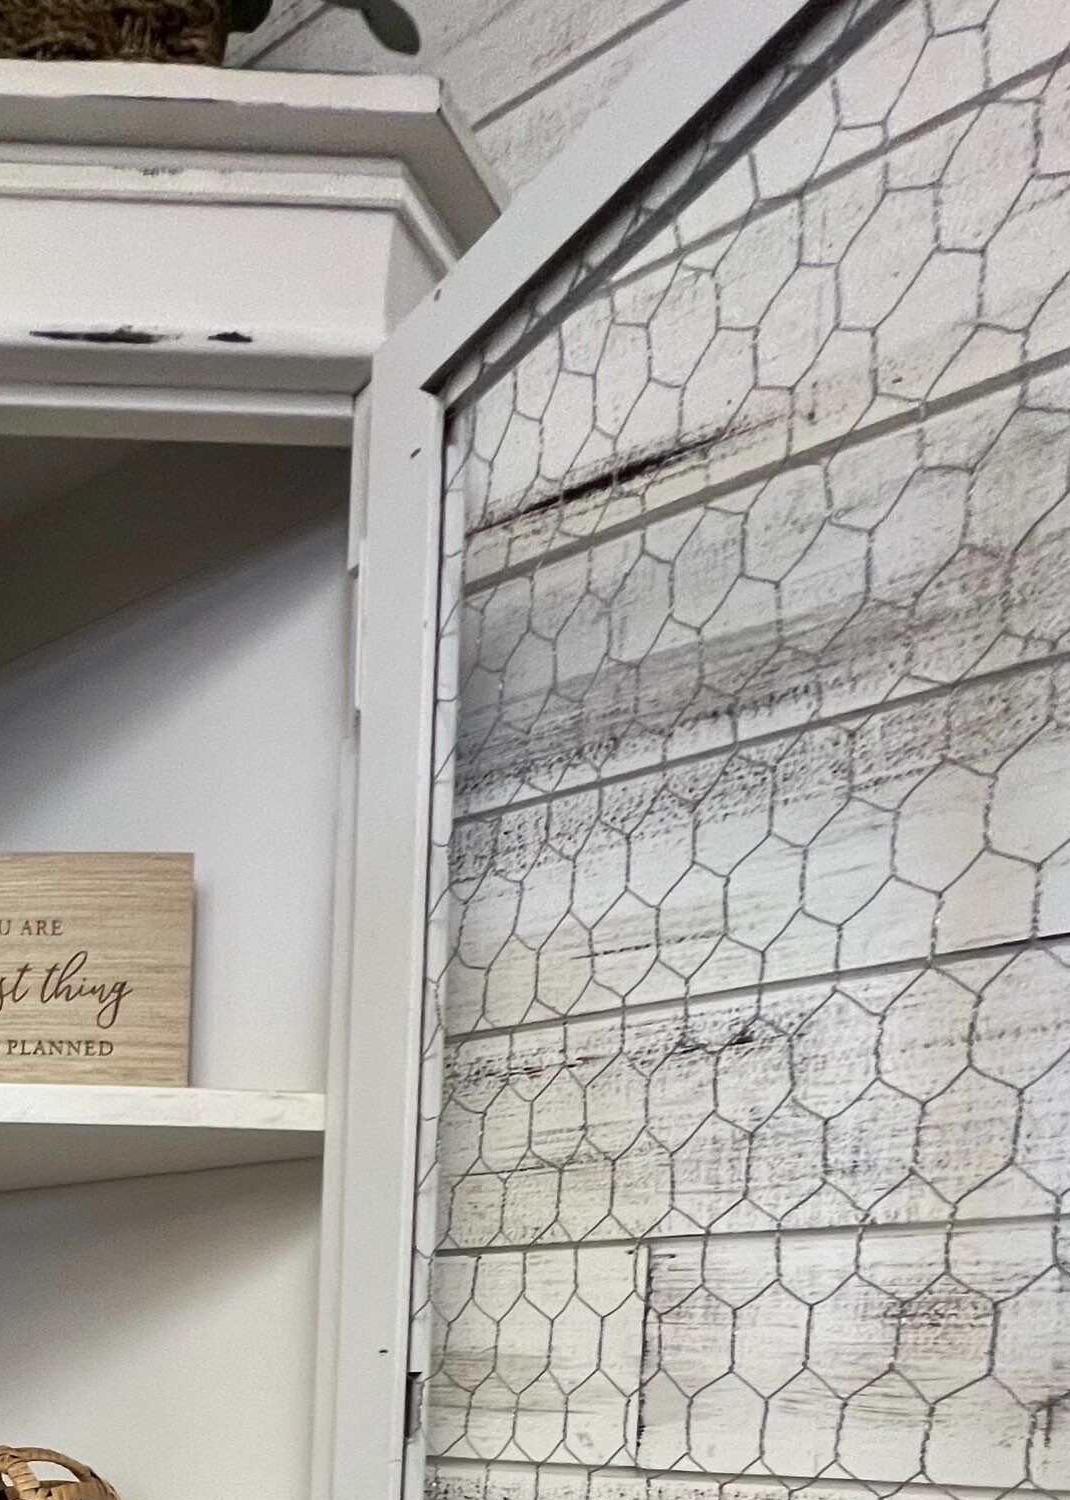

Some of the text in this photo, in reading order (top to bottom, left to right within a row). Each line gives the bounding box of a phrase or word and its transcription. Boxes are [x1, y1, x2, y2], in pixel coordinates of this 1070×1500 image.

[20, 920, 63, 937] ARE
[39, 950, 134, 1030] thing
[6, 1040, 115, 1057] PLANNED
